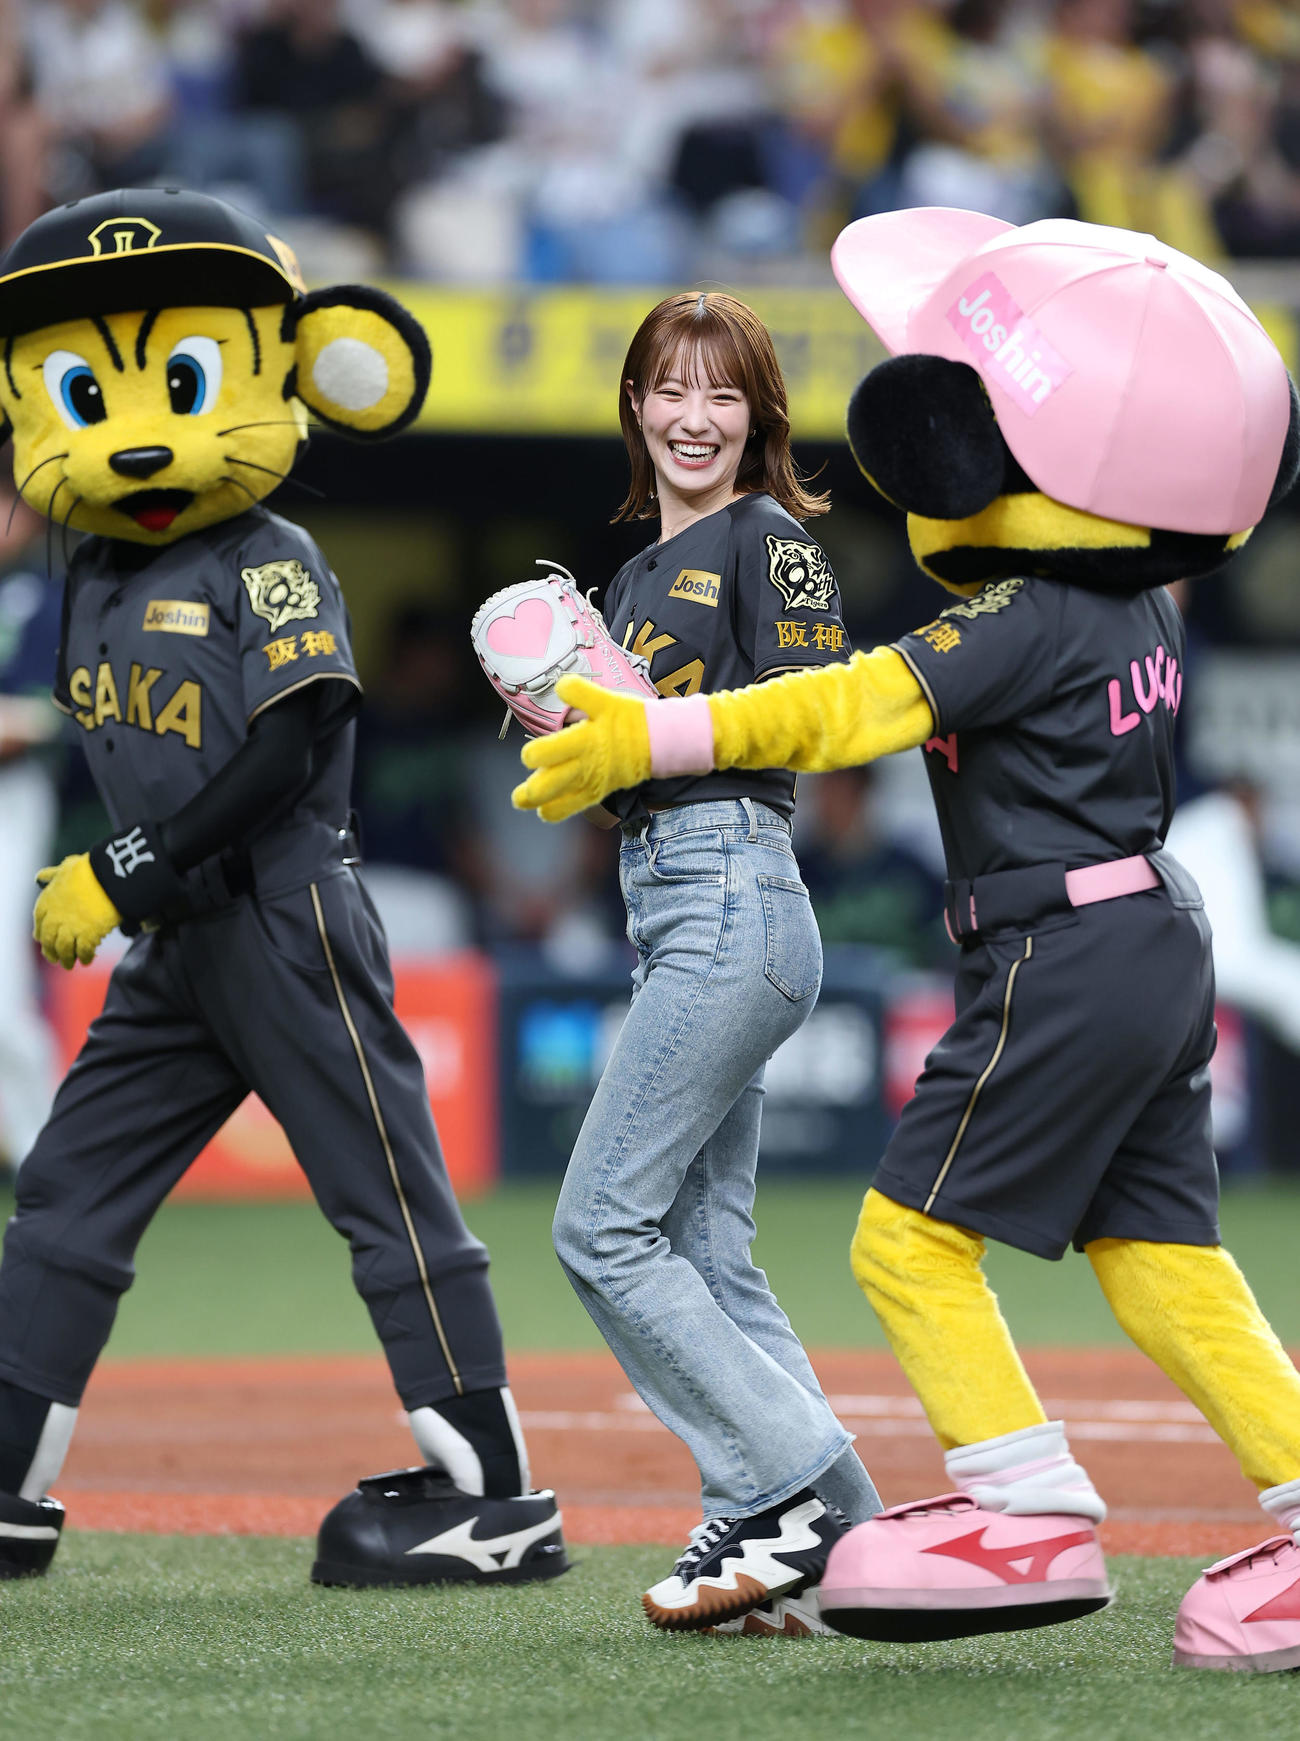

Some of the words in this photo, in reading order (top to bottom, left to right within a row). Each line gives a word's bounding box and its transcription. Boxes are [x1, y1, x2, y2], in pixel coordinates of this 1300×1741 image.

[957, 289, 1052, 404] Joshin
[146, 607, 207, 628] Joshin
[773, 620, 845, 652] 阪神
[261, 630, 338, 672] 阪神
[621, 619, 706, 699] KA
